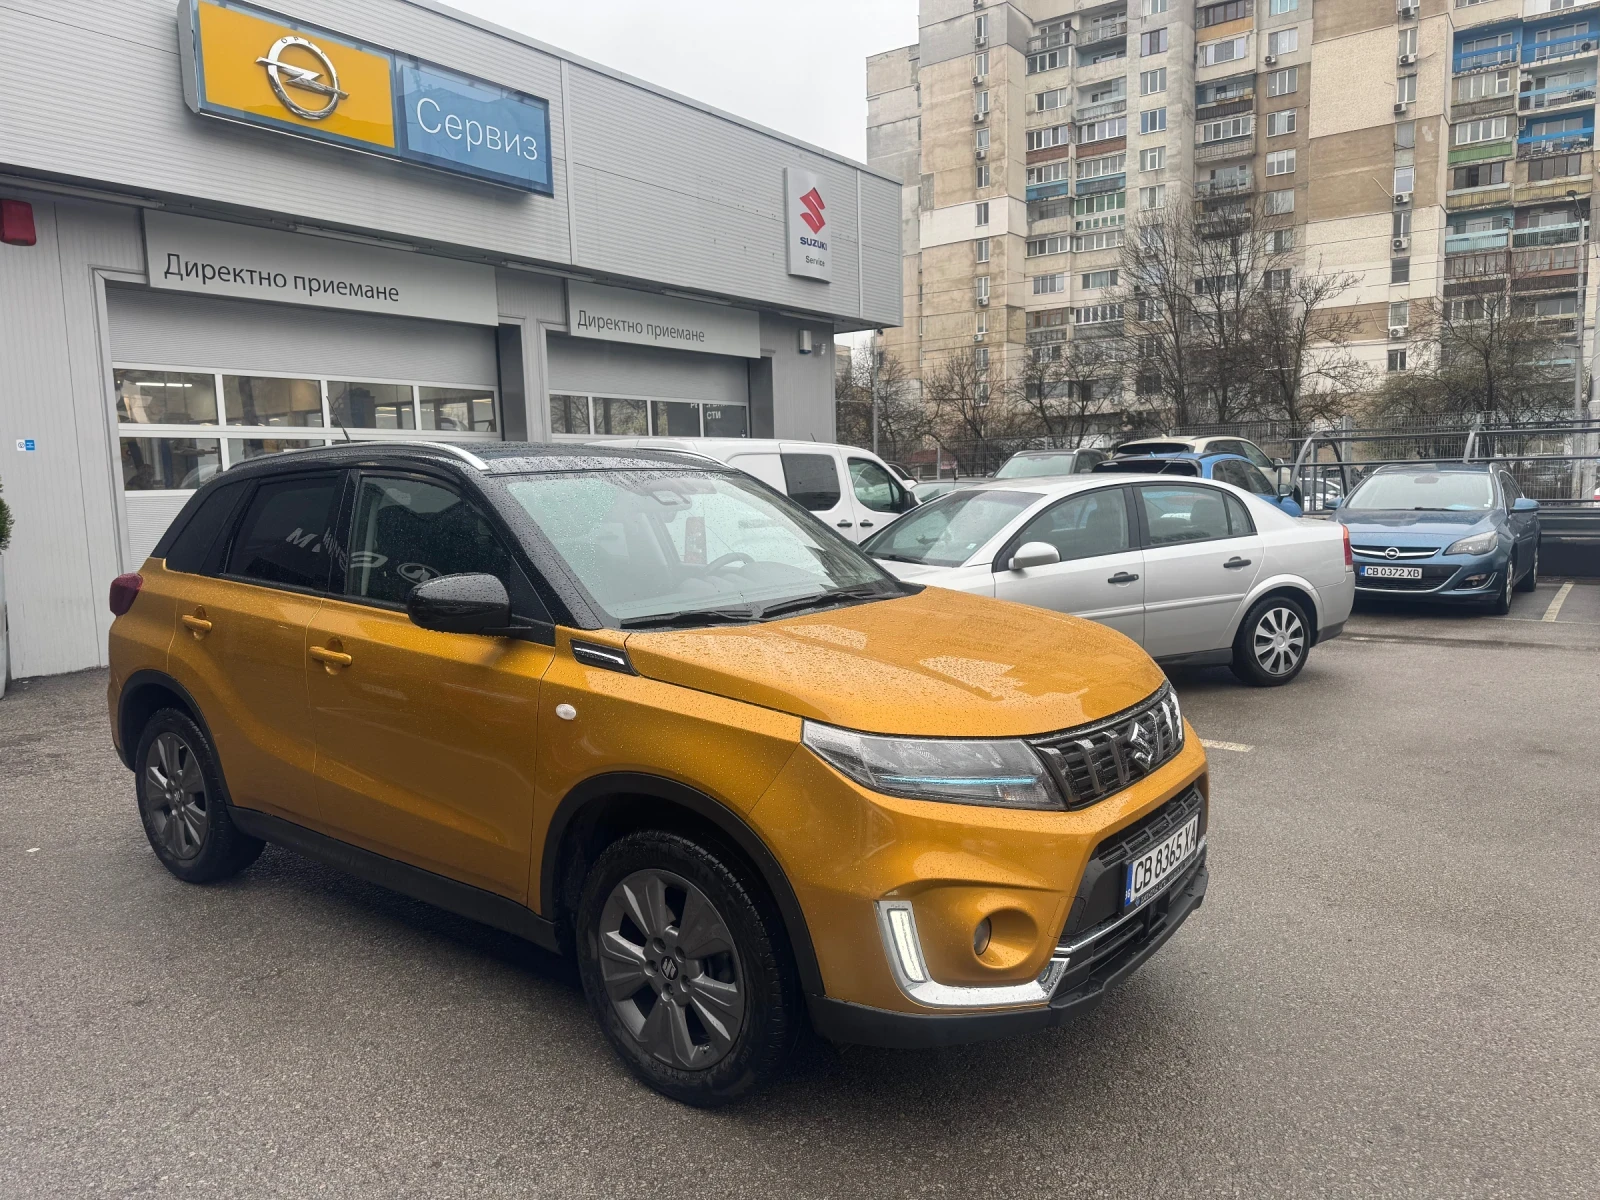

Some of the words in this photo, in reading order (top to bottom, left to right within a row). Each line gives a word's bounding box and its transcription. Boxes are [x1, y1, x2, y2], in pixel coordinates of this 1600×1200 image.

[416, 97, 538, 161] Сервиз
[799, 236, 828, 251] SUZUKI
[164, 252, 287, 288] Директно
[293, 274, 400, 302] приемане
[805, 255, 825, 268] Service
[577, 309, 643, 334] Директно
[646, 323, 705, 343] приемане
[1366, 567, 1379, 576] CB
[1380, 567, 1405, 577] 0372
[1406, 568, 1420, 578] XB
[1135, 856, 1152, 893] CB
[1155, 832, 1182, 878] 8365
[1184, 820, 1195, 854] XA
